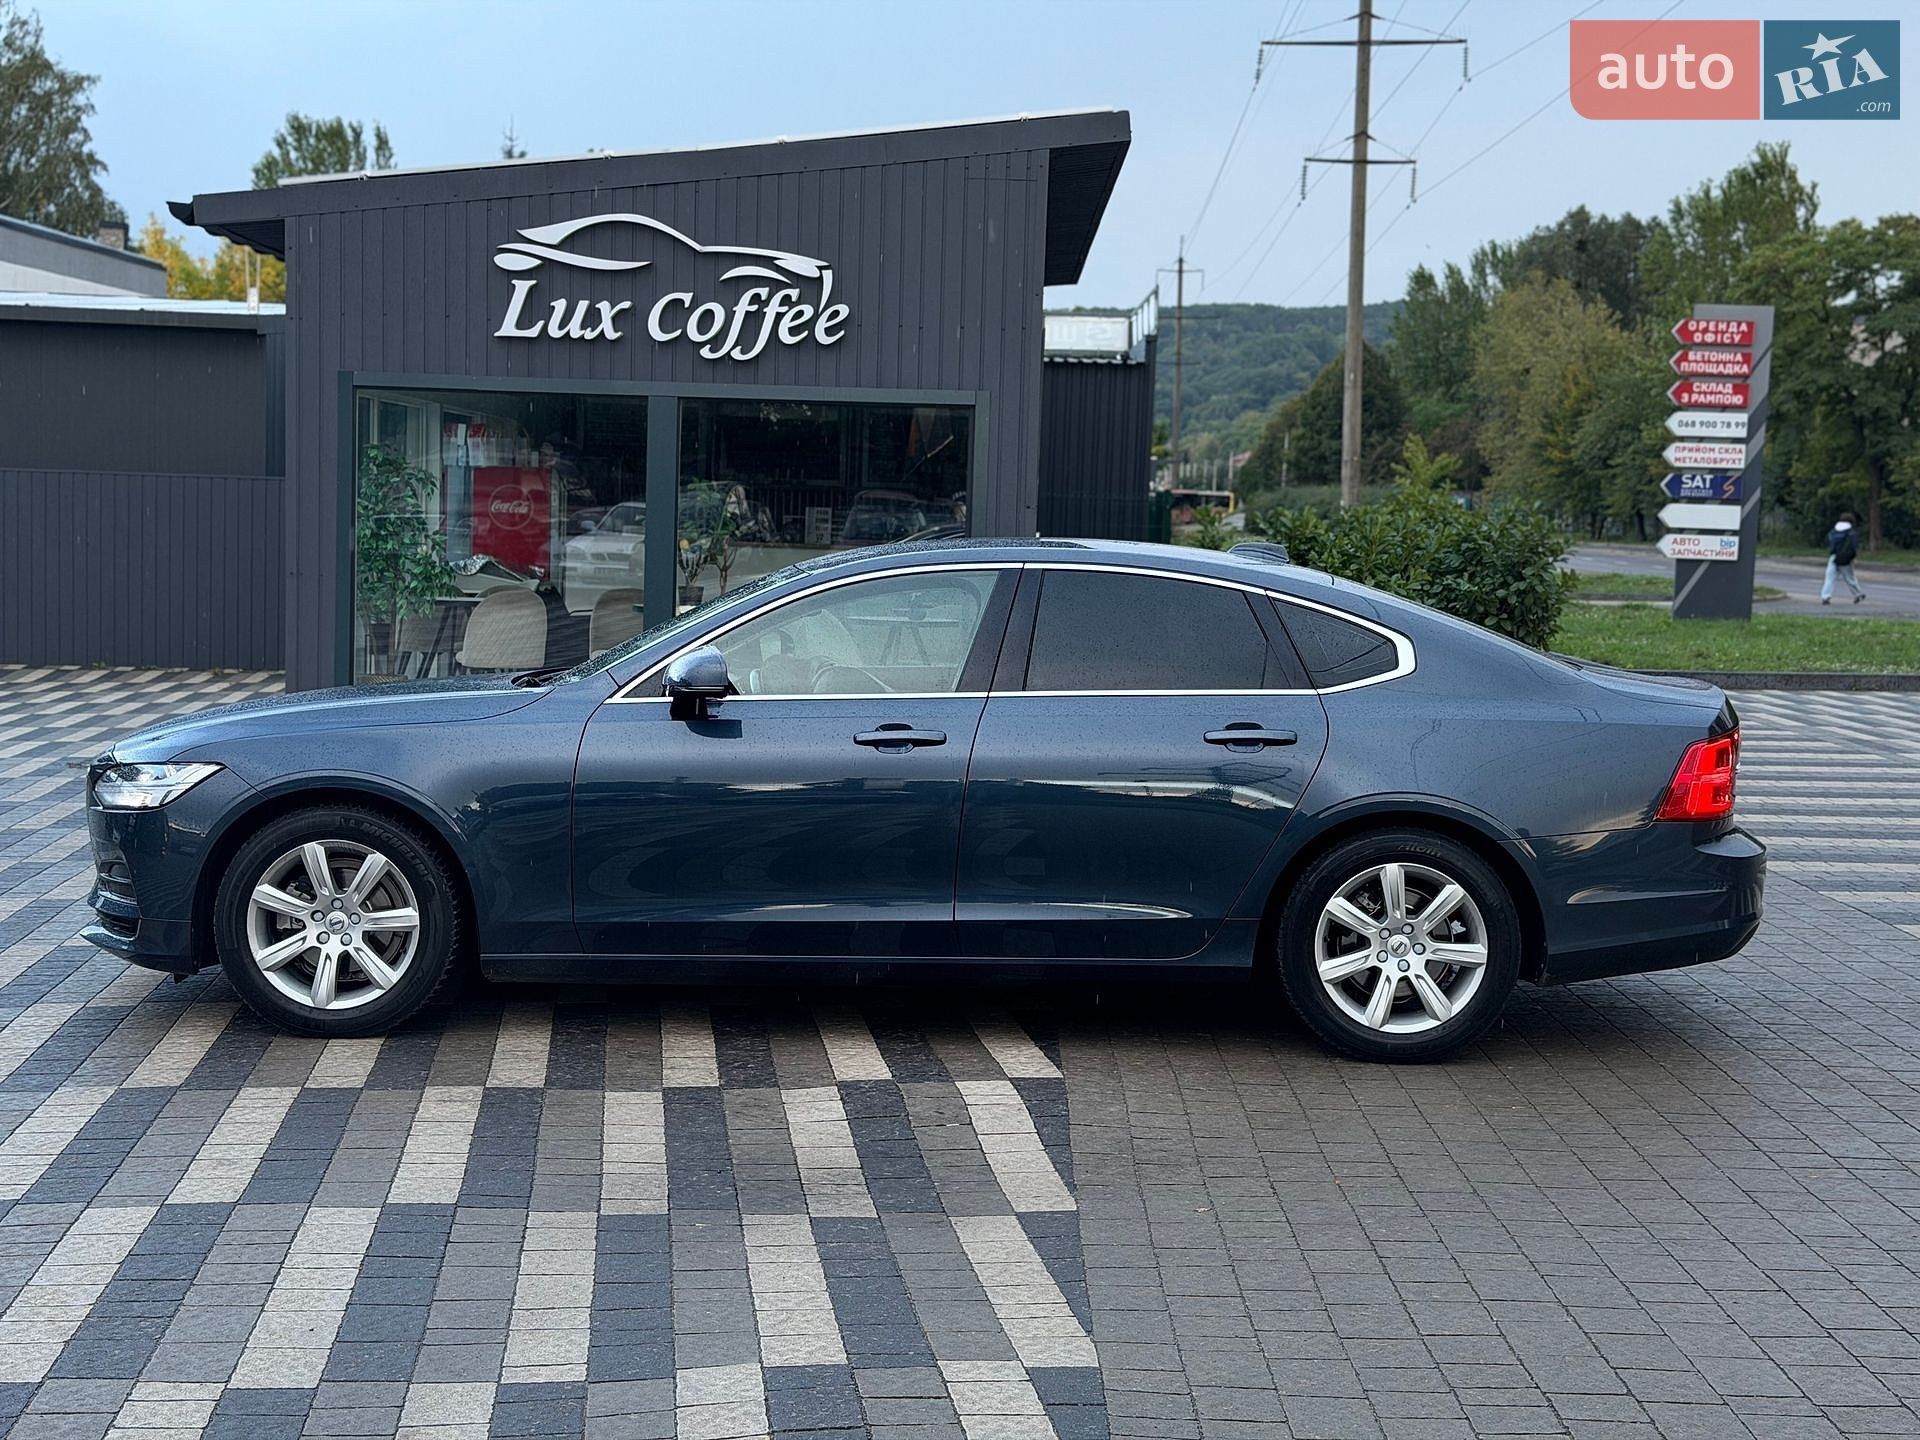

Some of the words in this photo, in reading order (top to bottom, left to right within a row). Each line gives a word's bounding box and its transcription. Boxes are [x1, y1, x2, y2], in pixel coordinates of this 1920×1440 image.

[493, 279, 633, 341] Lux
[647, 287, 850, 361] Coffee
[1688, 321, 1748, 333] ОРЕНДА
[1693, 333, 1742, 343] ОФІСУ
[1688, 351, 1743, 362] БЕТОННА
[1680, 362, 1749, 375] ПЛОЩАДКА
[1693, 383, 1734, 394] СКЛАД
[1691, 394, 1743, 404] РАМПОЮ
[1678, 419, 1696, 428] 068
[1674, 444, 1716, 454] ПРИЙОМ
[1681, 475, 1714, 488] SAT
[1671, 537, 1700, 546] АВТО
[1671, 548, 1735, 558] ЗАПЧАСТИНИ
